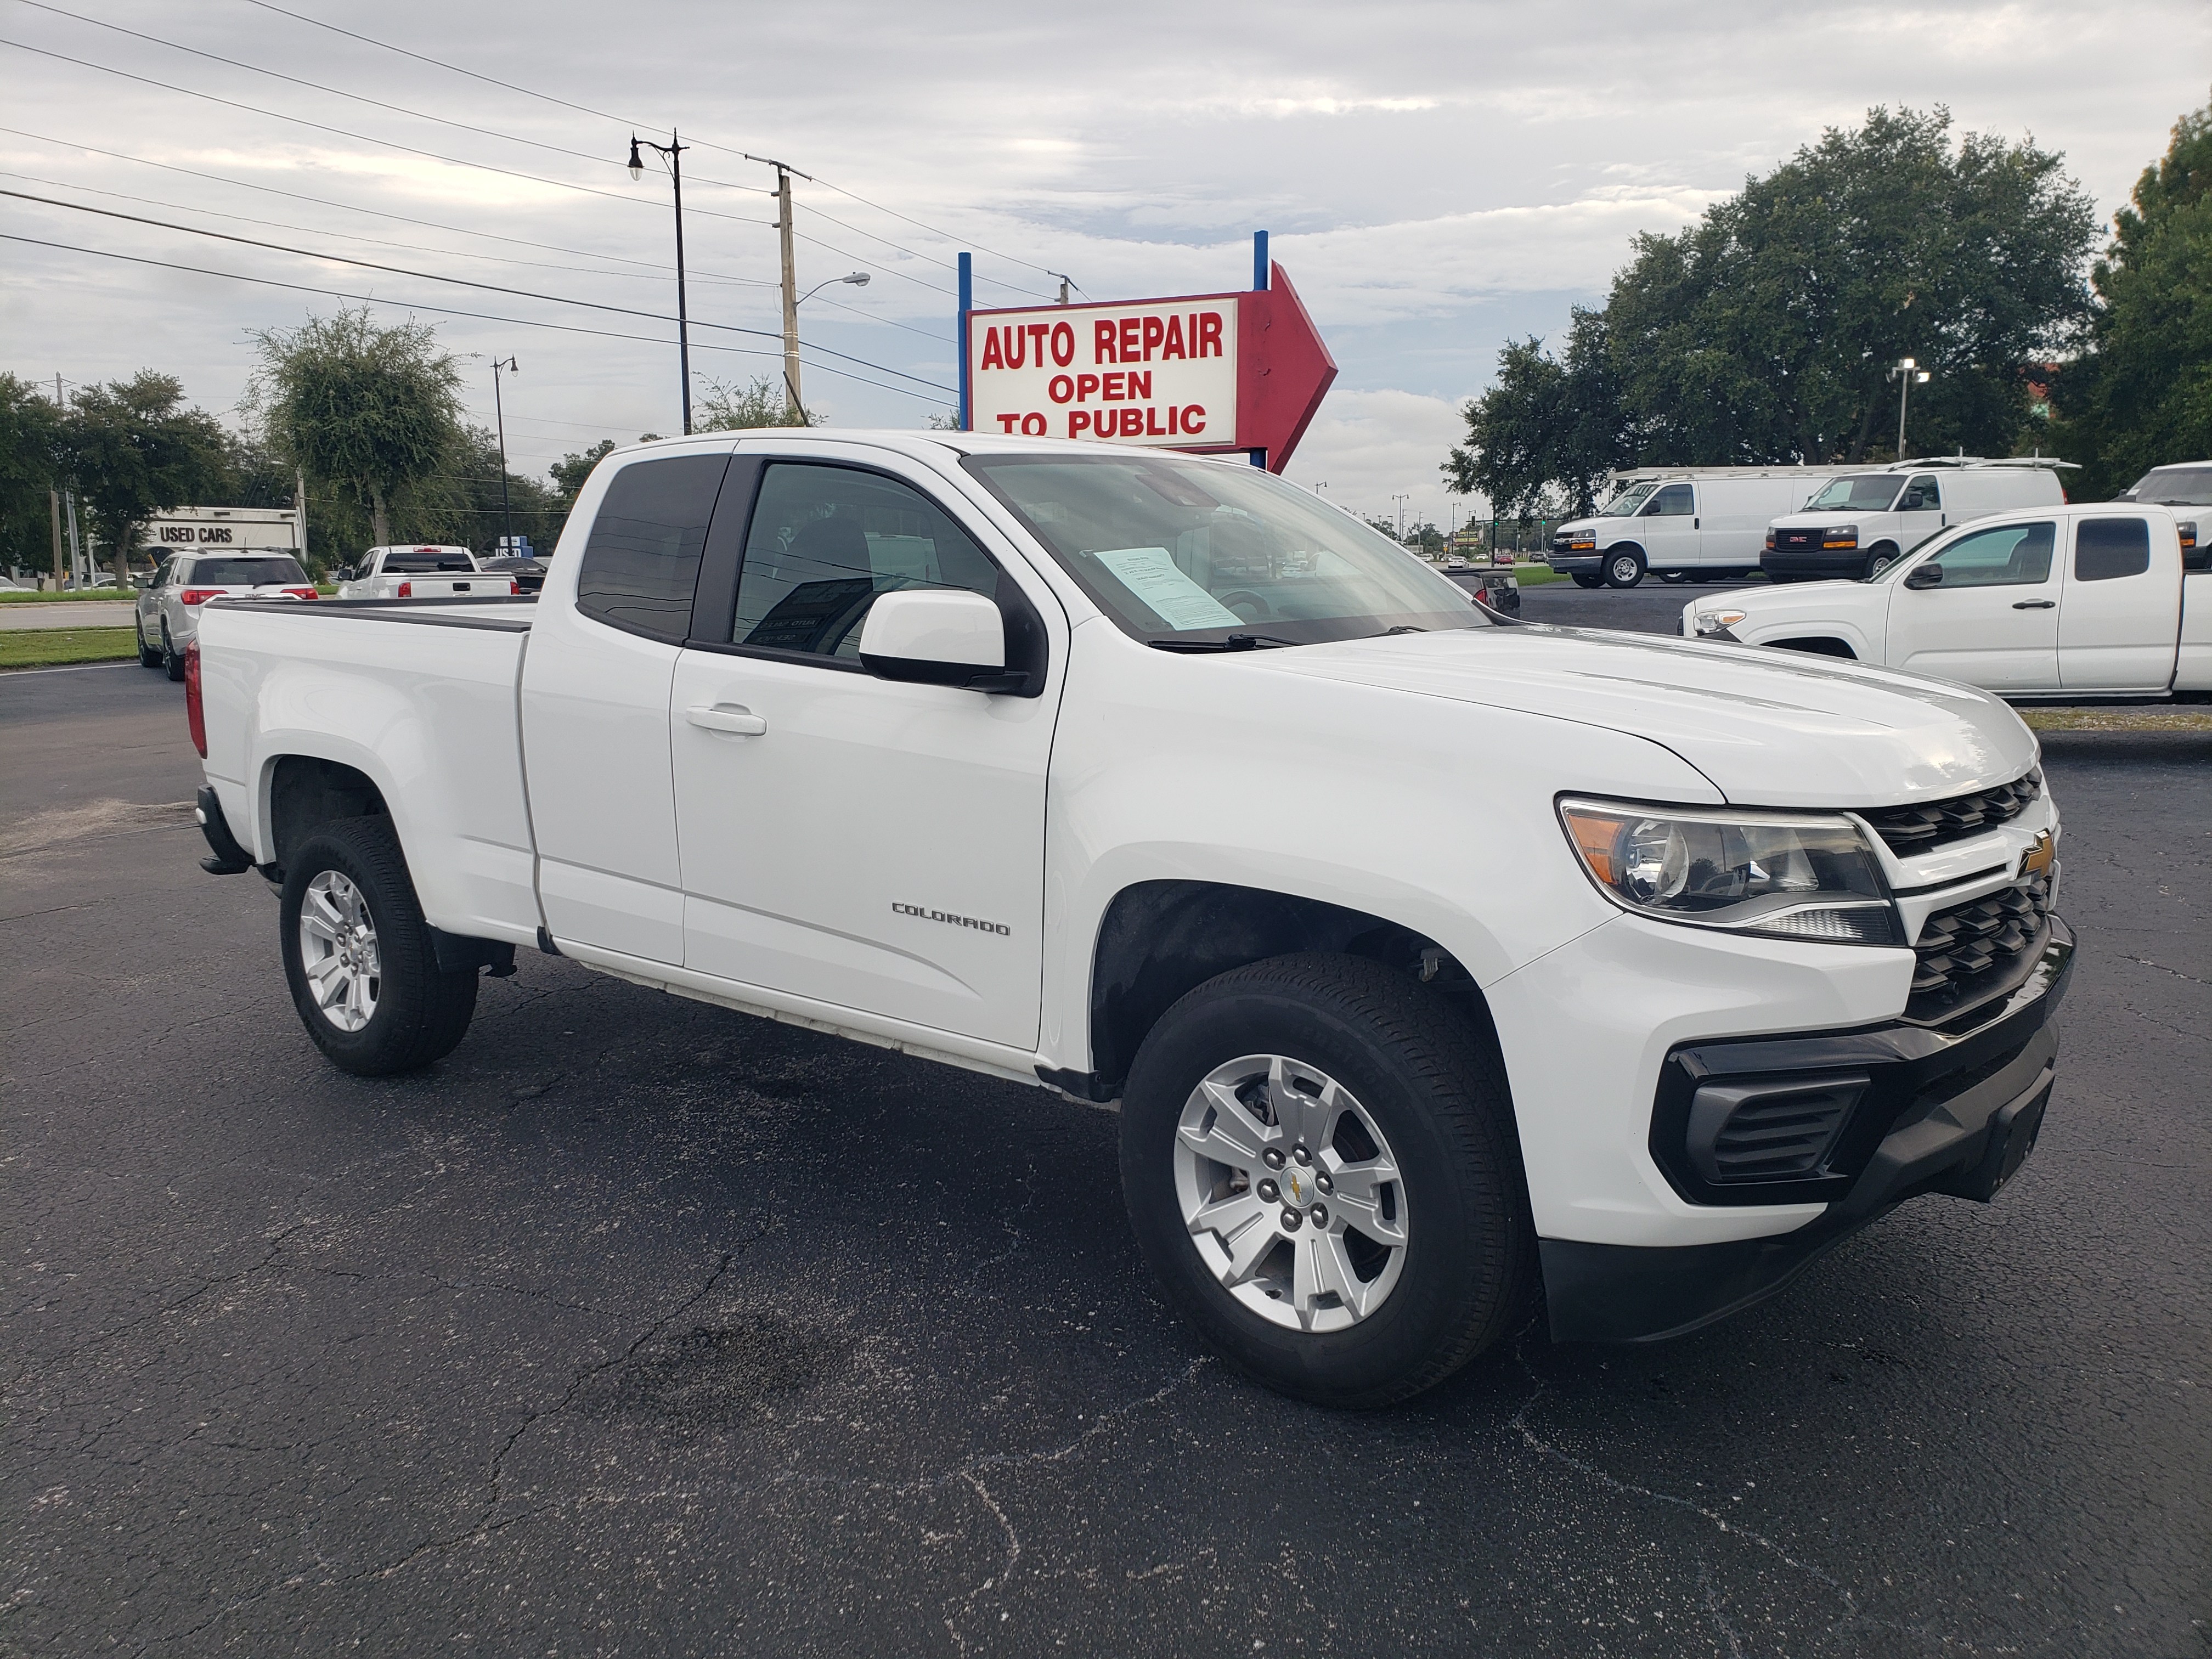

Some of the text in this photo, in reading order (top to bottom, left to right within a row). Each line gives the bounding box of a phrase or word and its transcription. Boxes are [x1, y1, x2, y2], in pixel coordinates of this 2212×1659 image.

[981, 312, 1223, 370] AUTO REPAIR
[1048, 370, 1152, 404] OPEN
[997, 404, 1206, 439] TO PUBLIC
[160, 527, 233, 543] USED CARS
[891, 902, 1011, 936] COLORADO
